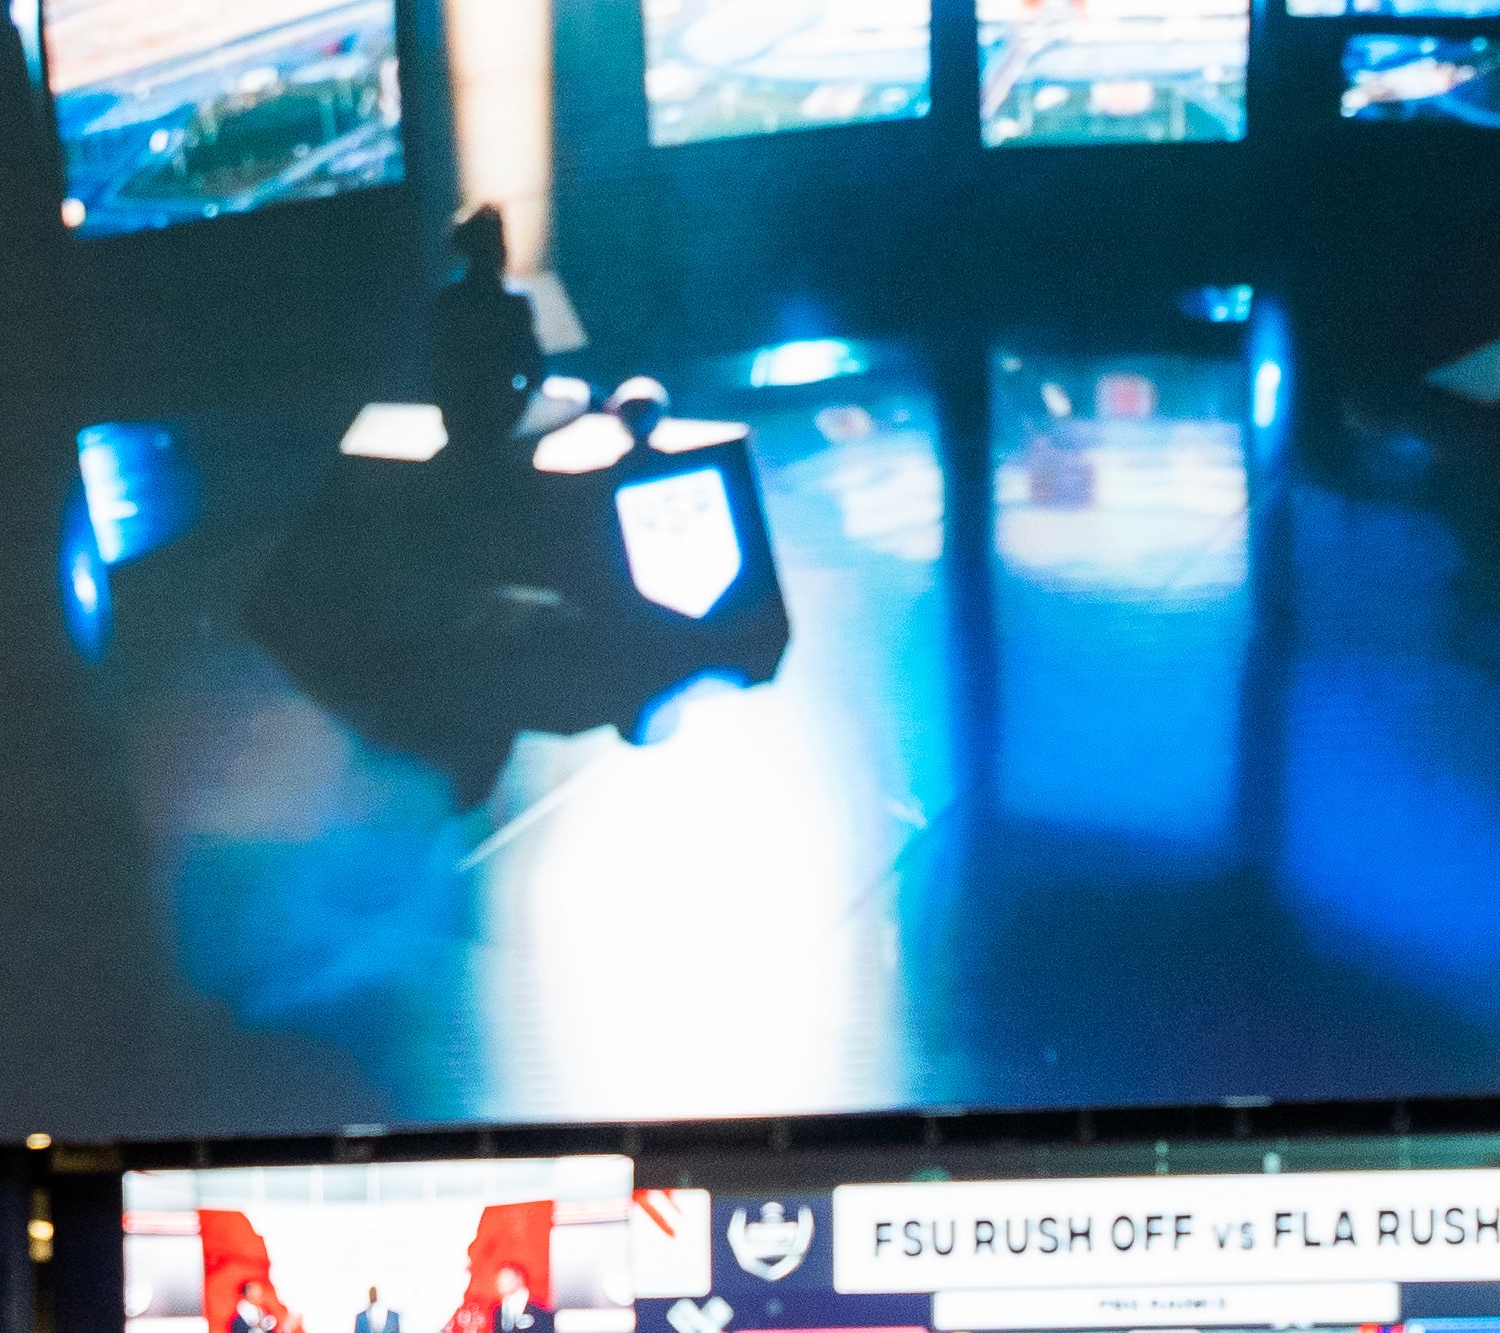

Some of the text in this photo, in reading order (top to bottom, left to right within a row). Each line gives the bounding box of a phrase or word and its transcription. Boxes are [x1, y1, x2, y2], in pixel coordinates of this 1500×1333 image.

[874, 1219, 955, 1258] FSU
[974, 1214, 1093, 1255] RUSH
[1110, 1212, 1194, 1252] OFF
[1272, 1210, 1356, 1248] FLA
